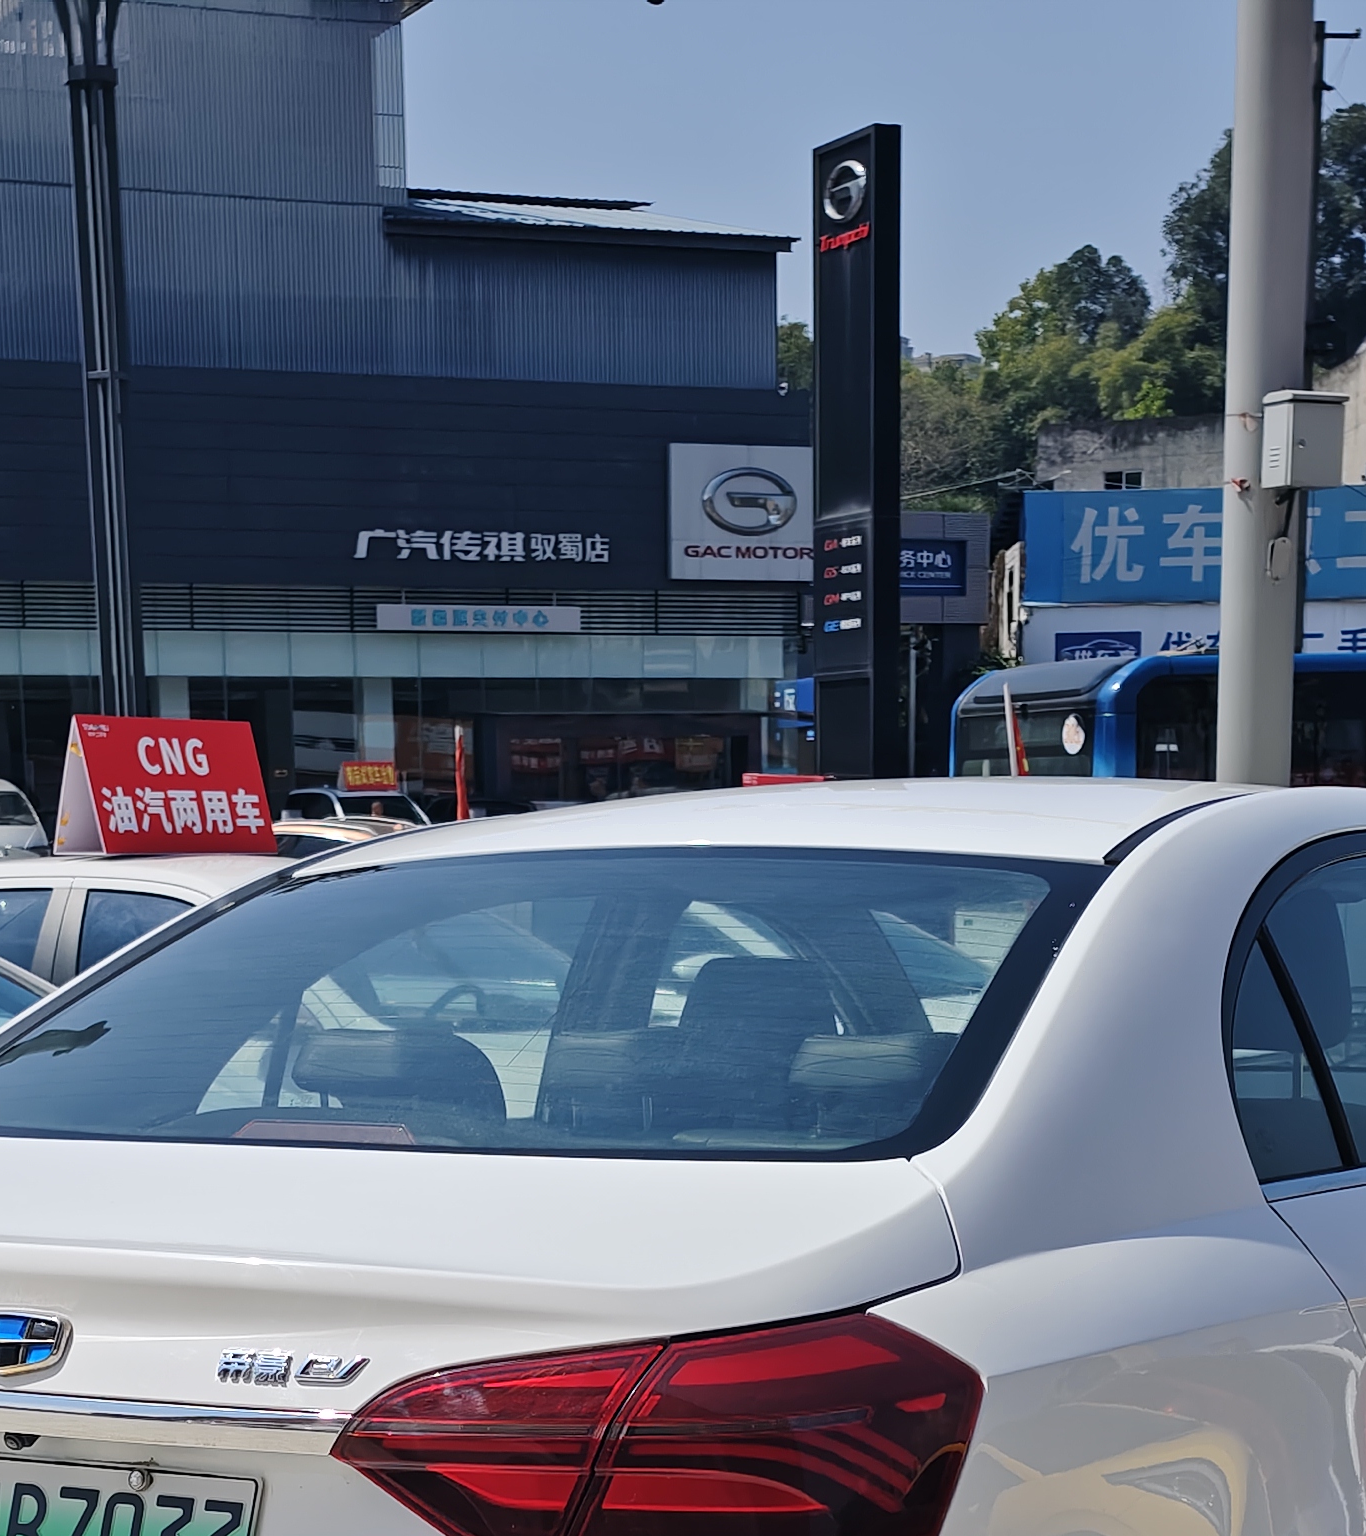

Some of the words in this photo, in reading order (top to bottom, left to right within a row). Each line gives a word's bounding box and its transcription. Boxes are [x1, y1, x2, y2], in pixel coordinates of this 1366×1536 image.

[684, 545, 732, 558] GAC
[735, 546, 815, 560] MOTOR
[137, 736, 210, 776] CNG
[101, 786, 265, 835] 油汽两用车
